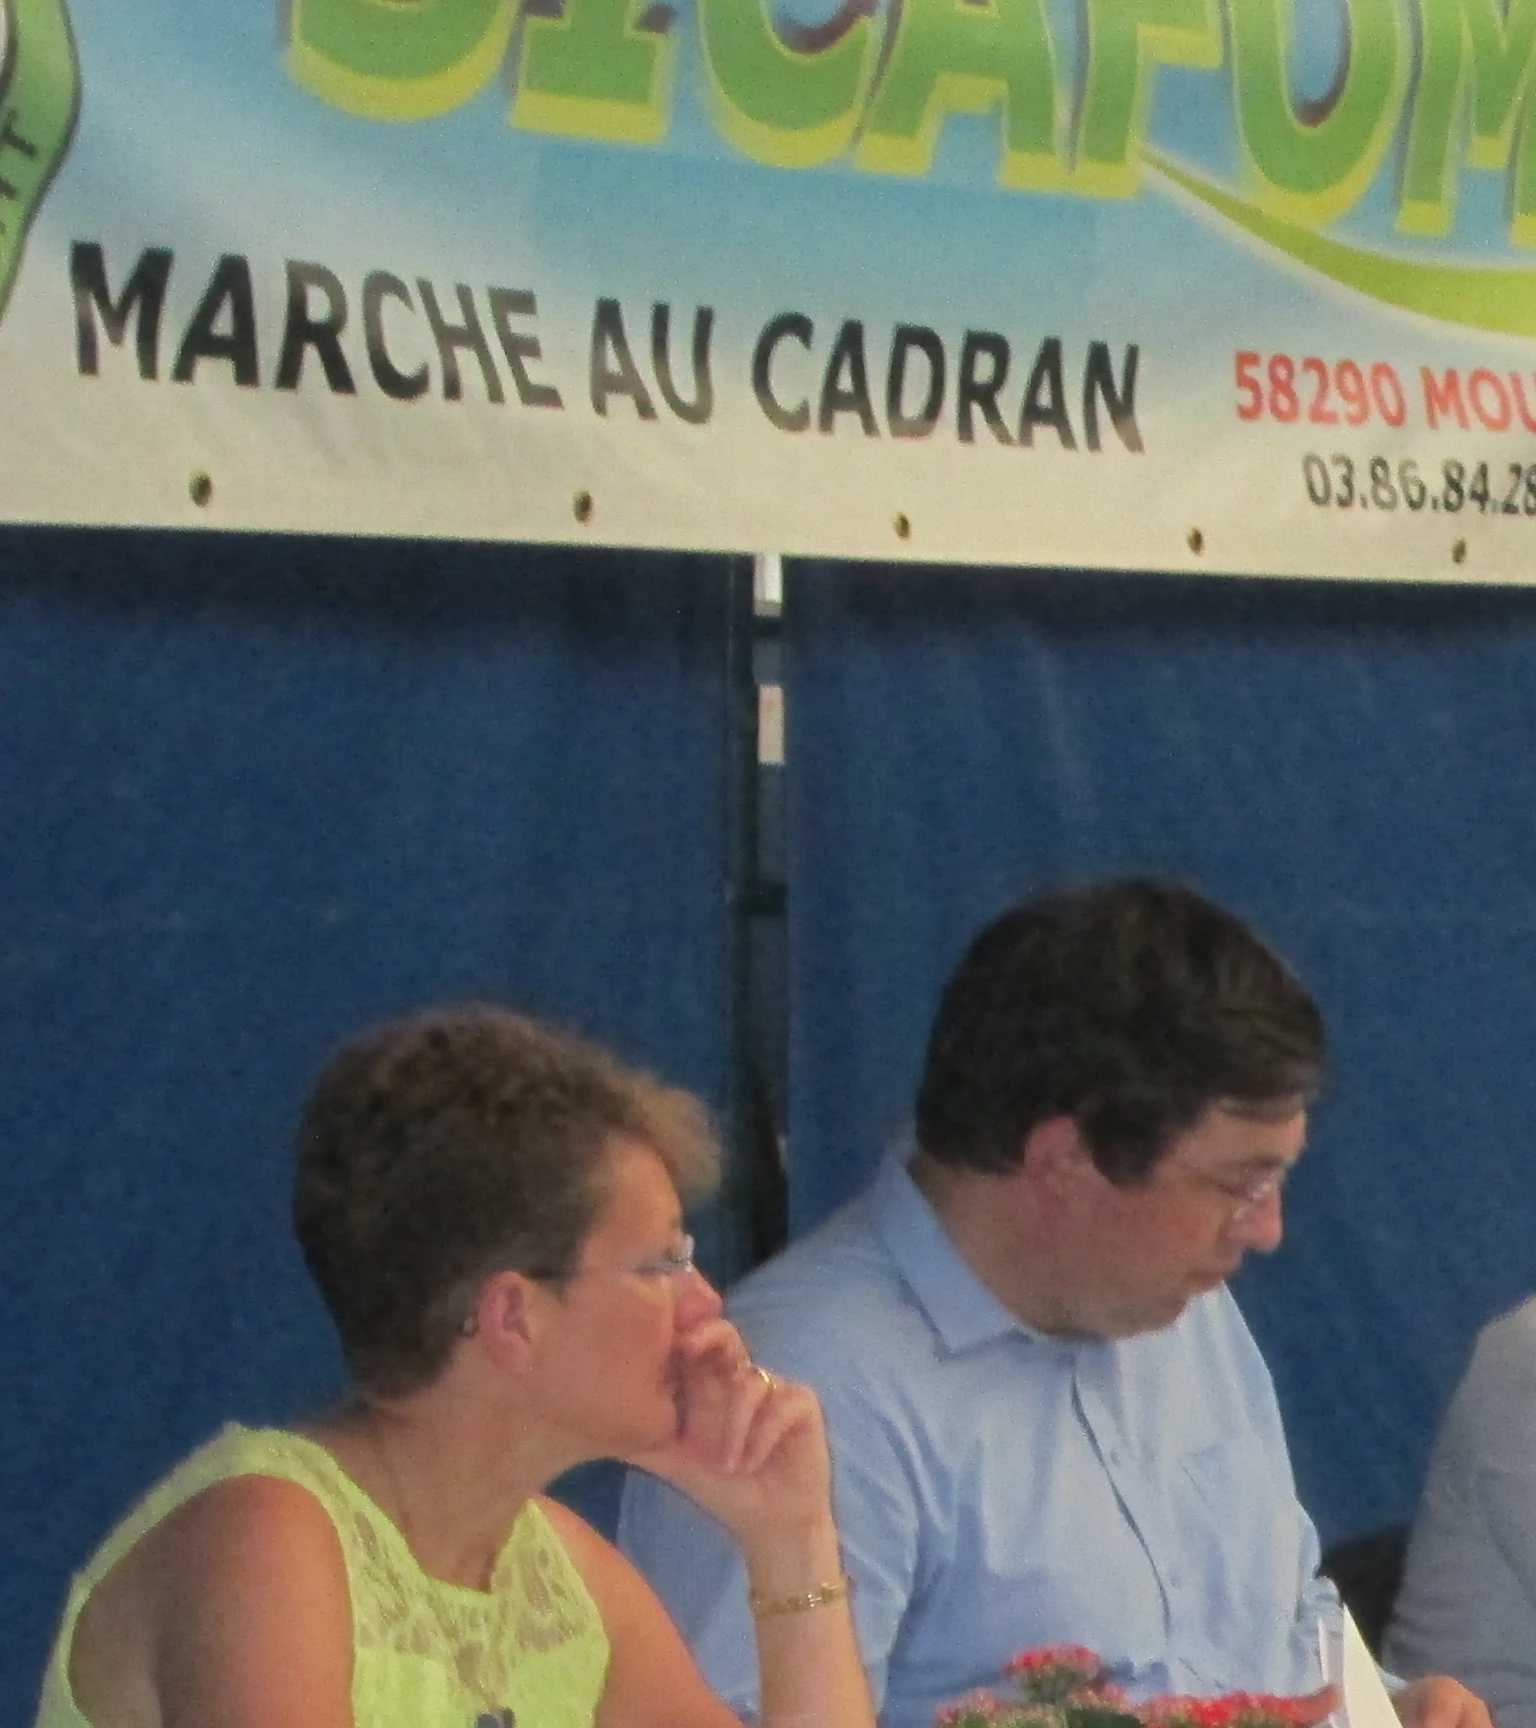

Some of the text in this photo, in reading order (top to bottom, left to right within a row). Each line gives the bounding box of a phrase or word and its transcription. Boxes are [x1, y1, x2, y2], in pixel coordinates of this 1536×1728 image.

[69, 240, 1146, 455] MARCHE AU CADRAN
[1234, 350, 1407, 428] 58290
